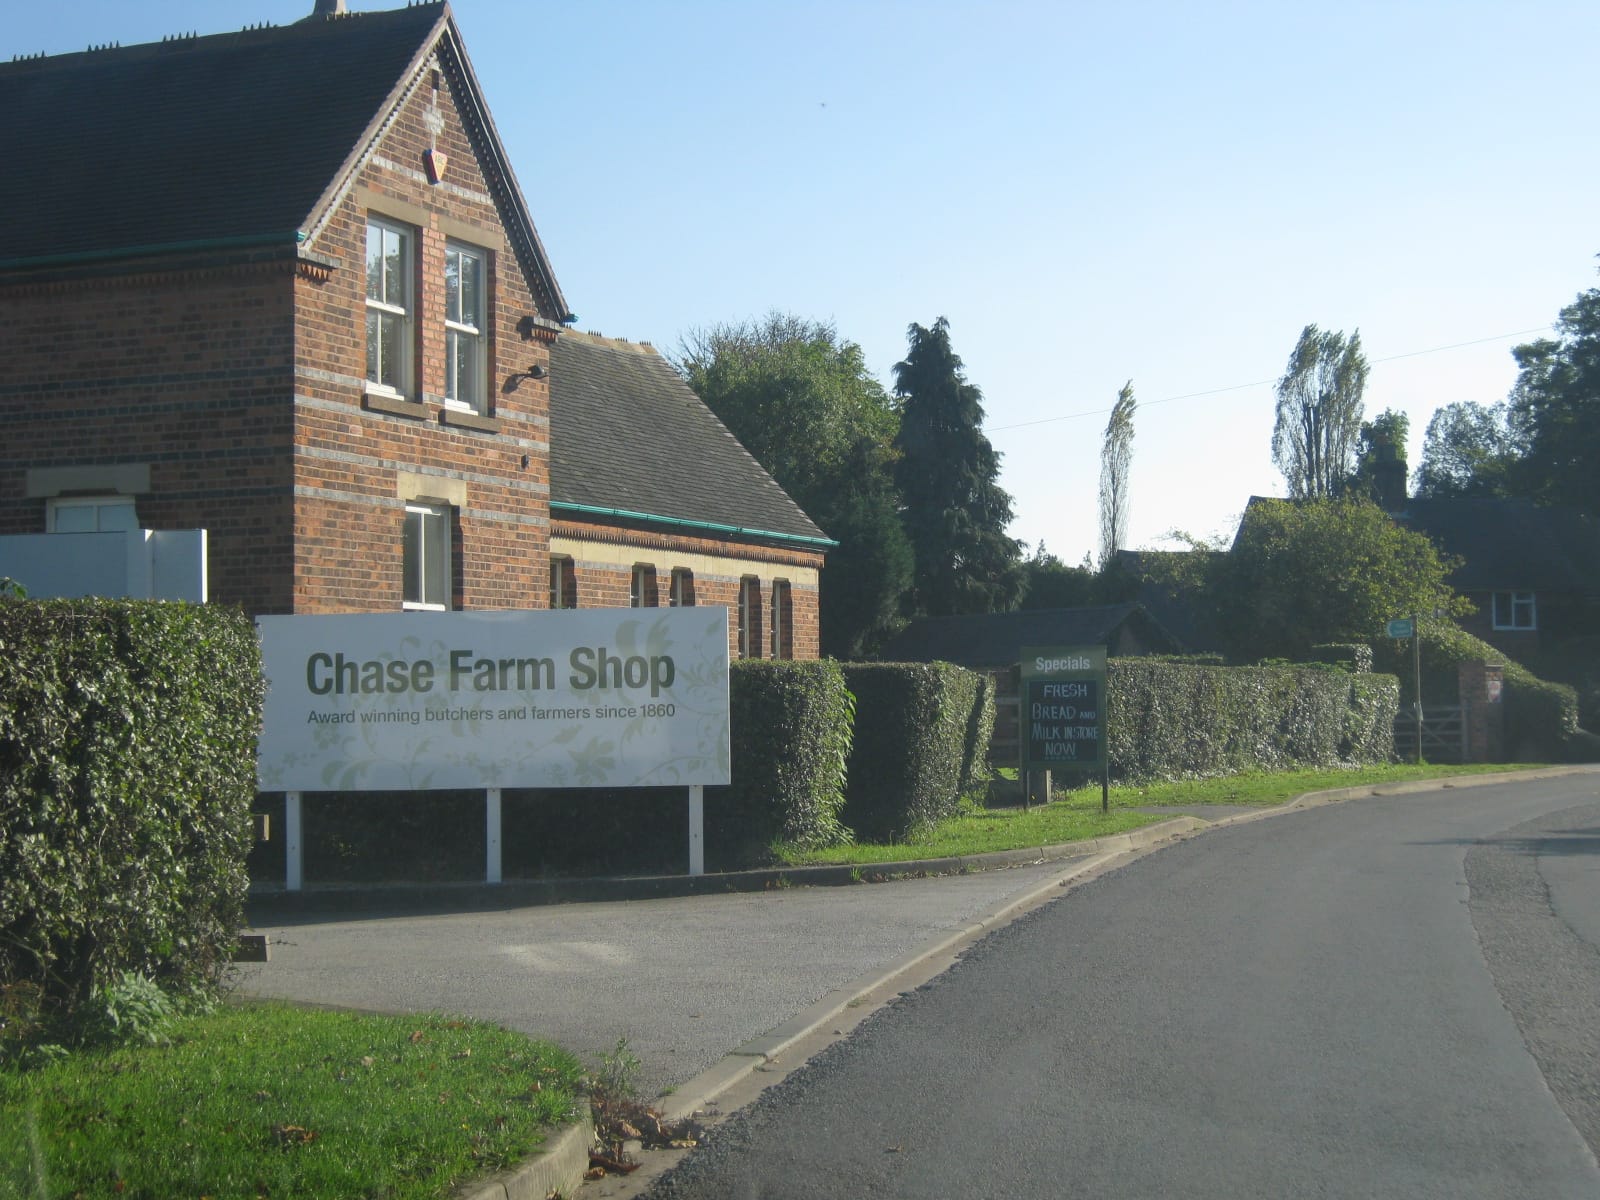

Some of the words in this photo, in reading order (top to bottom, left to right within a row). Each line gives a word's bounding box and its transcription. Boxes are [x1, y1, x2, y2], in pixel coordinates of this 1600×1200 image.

[306, 652, 435, 695] Chase
[450, 650, 555, 691] Farm
[569, 646, 675, 697] Shop
[1035, 656, 1090, 672] Specials
[1043, 683, 1088, 698] FRESH
[307, 710, 355, 724] Award
[360, 708, 420, 725] winning
[425, 707, 494, 722] butchers
[498, 706, 527, 720] and
[531, 705, 591, 720] farmers
[595, 704, 637, 719] since
[640, 703, 676, 718] 1860
[1032, 702, 1077, 720] BREAD
[1080, 711, 1096, 719] AND
[1032, 722, 1060, 740] MILK
[1045, 742, 1077, 757] NOW
